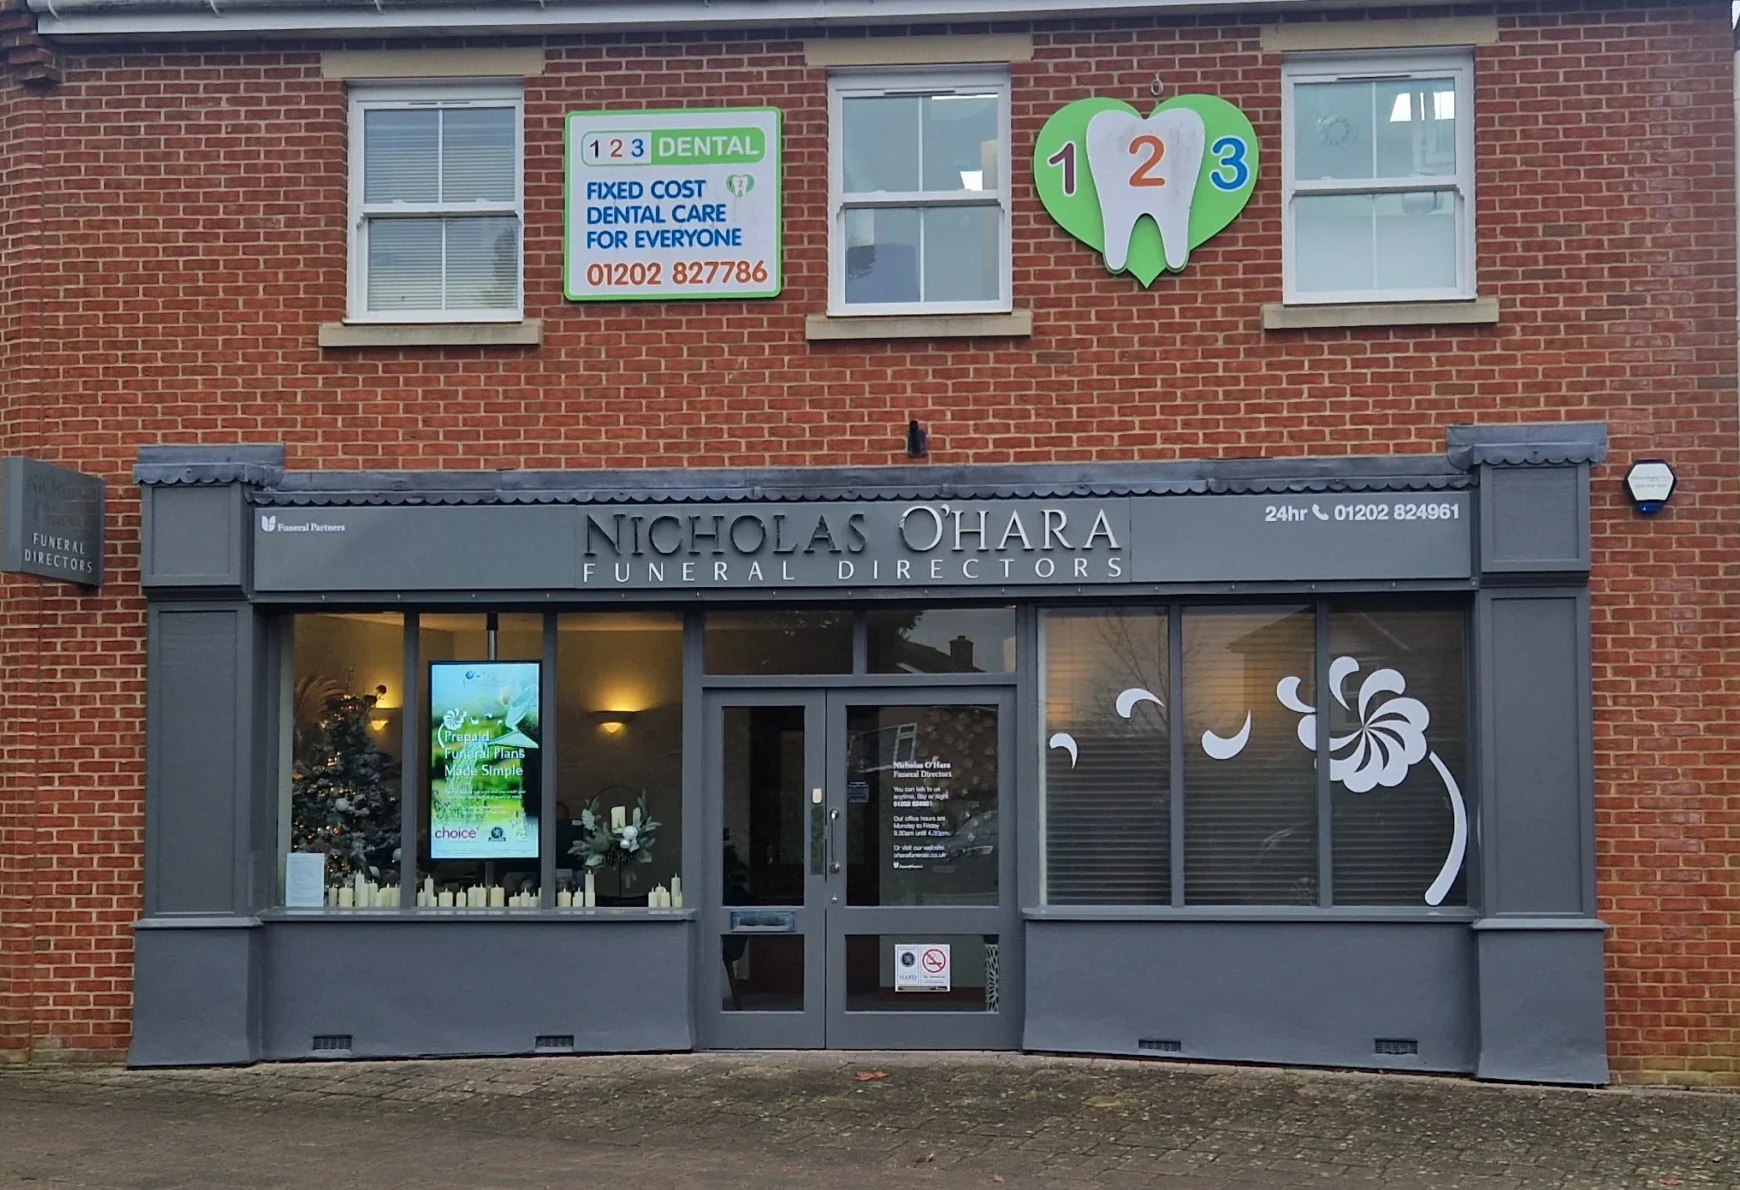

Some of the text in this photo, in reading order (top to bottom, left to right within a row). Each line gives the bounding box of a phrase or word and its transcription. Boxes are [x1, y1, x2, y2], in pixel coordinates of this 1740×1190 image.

[590, 136, 760, 158] 1 2 3 DENTAL
[1049, 135, 1250, 196] 1 2 3
[586, 180, 707, 200] FIXED COST
[586, 203, 727, 224] DENTAL CARE
[586, 228, 742, 249] FOR EVERYONE
[586, 260, 768, 286] 01202 827786
[1265, 503, 1459, 522] 24hr 01202 824961
[277, 522, 345, 532] Funeral Partners
[584, 503, 1122, 556] NICHOLAS O'HARA
[33, 532, 85, 555] FUNERAL
[24, 549, 93, 574] DIRECTORS
[583, 558, 1122, 583] FUNERAL DIRECTORS
[444, 730, 490, 746] Prepaid
[444, 747, 525, 760] Funeral Plans
[444, 764, 523, 779] Made Simple
[893, 761, 923, 769] Nicholas
[893, 770, 952, 778] Funeral Directors
[434, 826, 477, 840] choice
